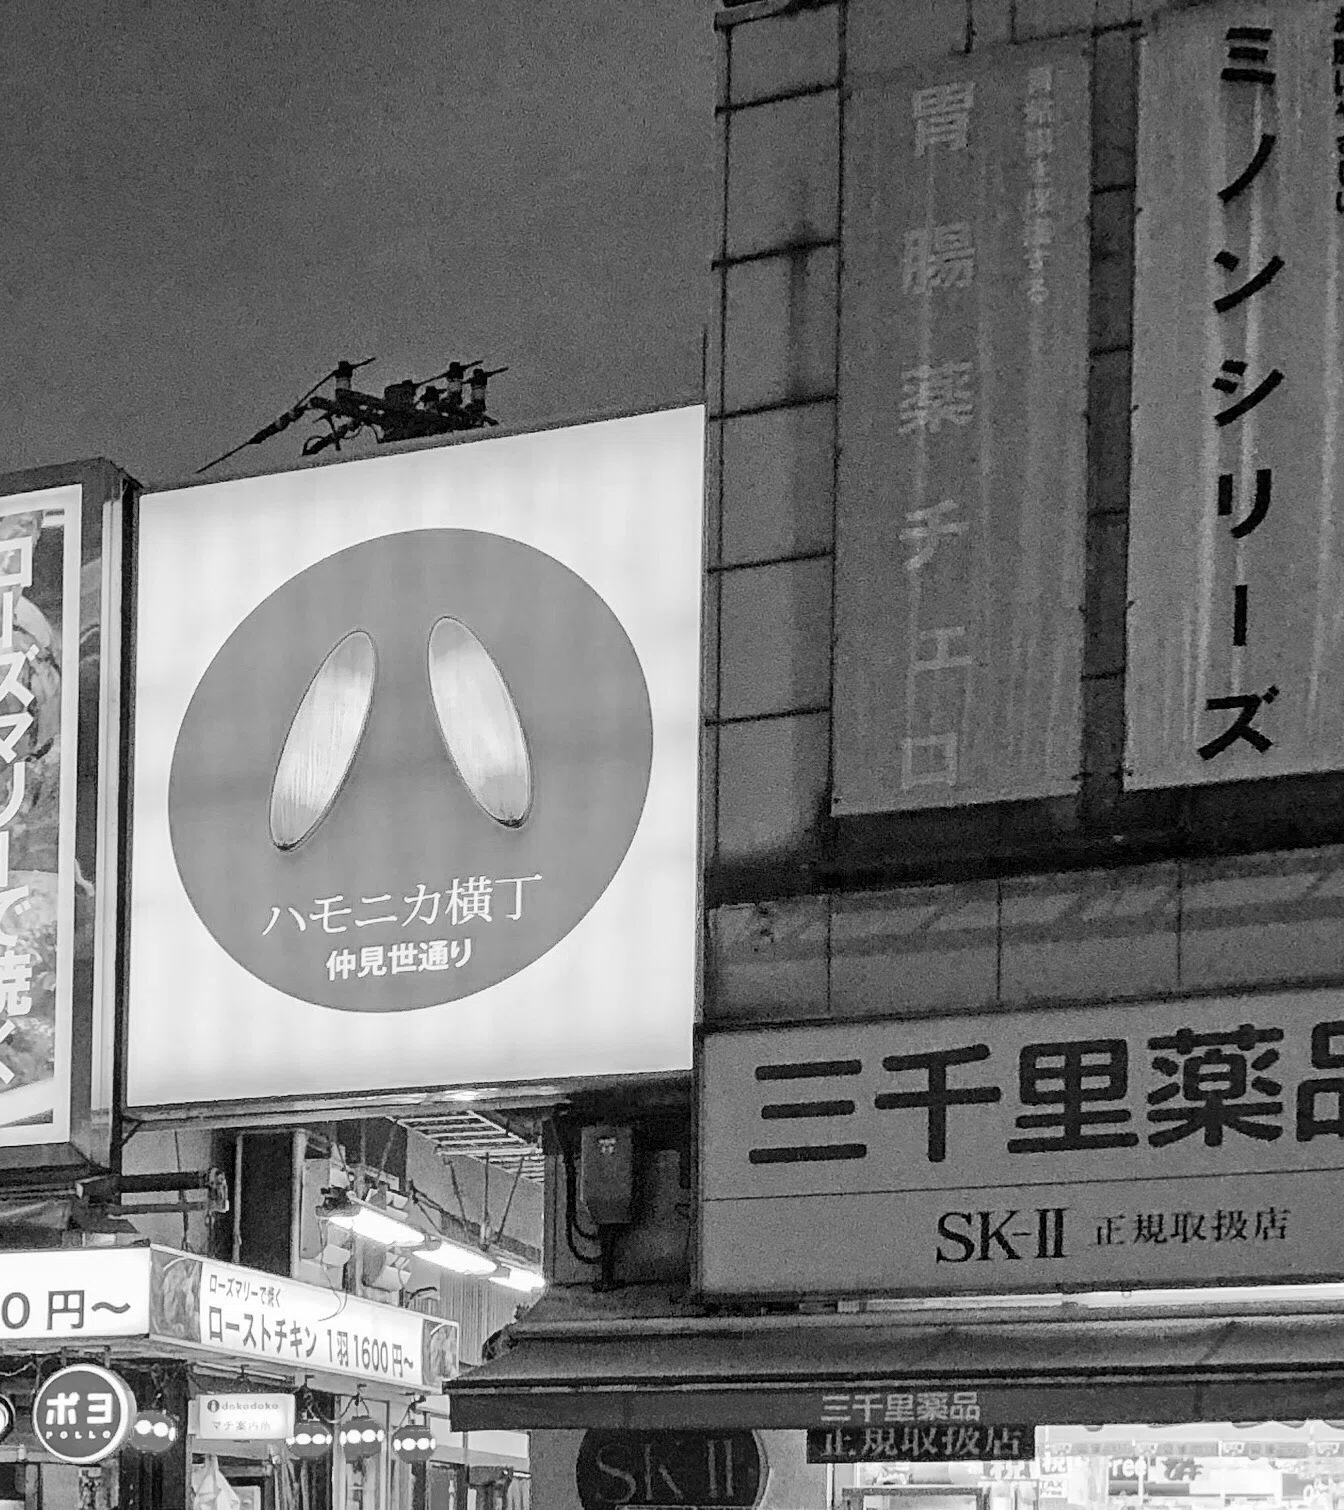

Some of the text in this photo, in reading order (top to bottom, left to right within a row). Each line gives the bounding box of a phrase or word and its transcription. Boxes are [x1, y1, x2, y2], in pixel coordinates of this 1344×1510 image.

[1198, 28, 1285, 763] ミノンシリーズ
[260, 873, 543, 937] ハモニカ横丁
[325, 939, 473, 982] 仲見世通り
[1092, 1205, 1292, 1248] 正規取扱店
[209, 1274, 282, 1308] ローズマリーで焼く
[208, 1305, 317, 1359] ローストチキン
[45, 1392, 113, 1426] ポヨ
[820, 1391, 981, 1423] 三千里薬品
[45, 1430, 112, 1440] POLLO
[1108, 1457, 1148, 1478] ree
